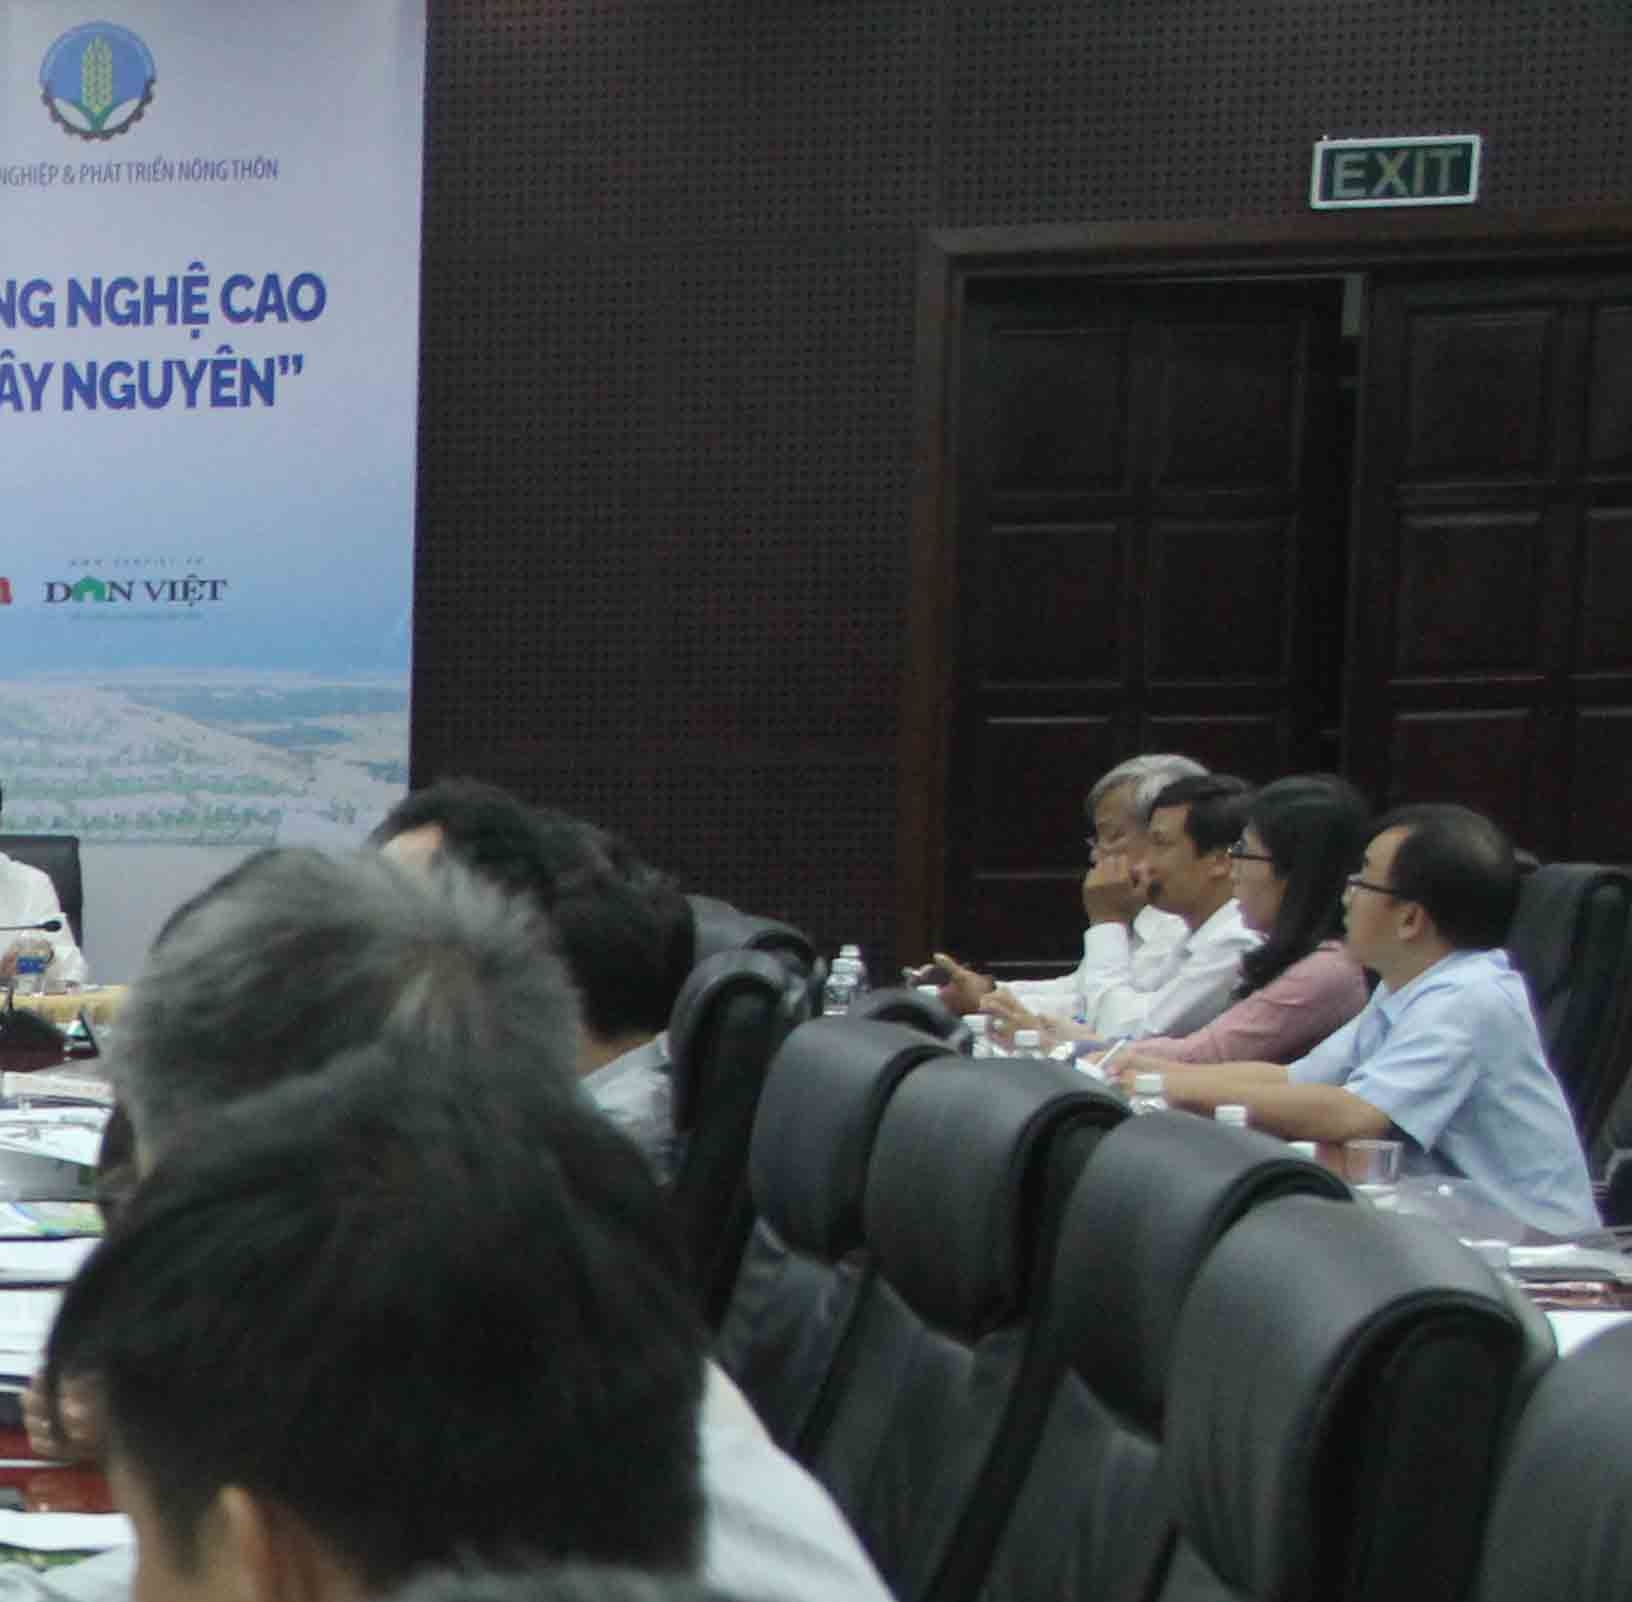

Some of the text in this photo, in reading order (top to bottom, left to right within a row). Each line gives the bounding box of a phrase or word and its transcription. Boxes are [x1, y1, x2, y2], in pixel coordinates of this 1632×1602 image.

[62, 163, 76, 186] &
[177, 156, 227, 183] NÔNG
[232, 154, 280, 182] THÔN
[1332, 146, 1463, 199] EXIT
[66, 261, 210, 340] NGHỆ
[219, 272, 328, 325] CAO
[142, 572, 228, 608] VIỆT
